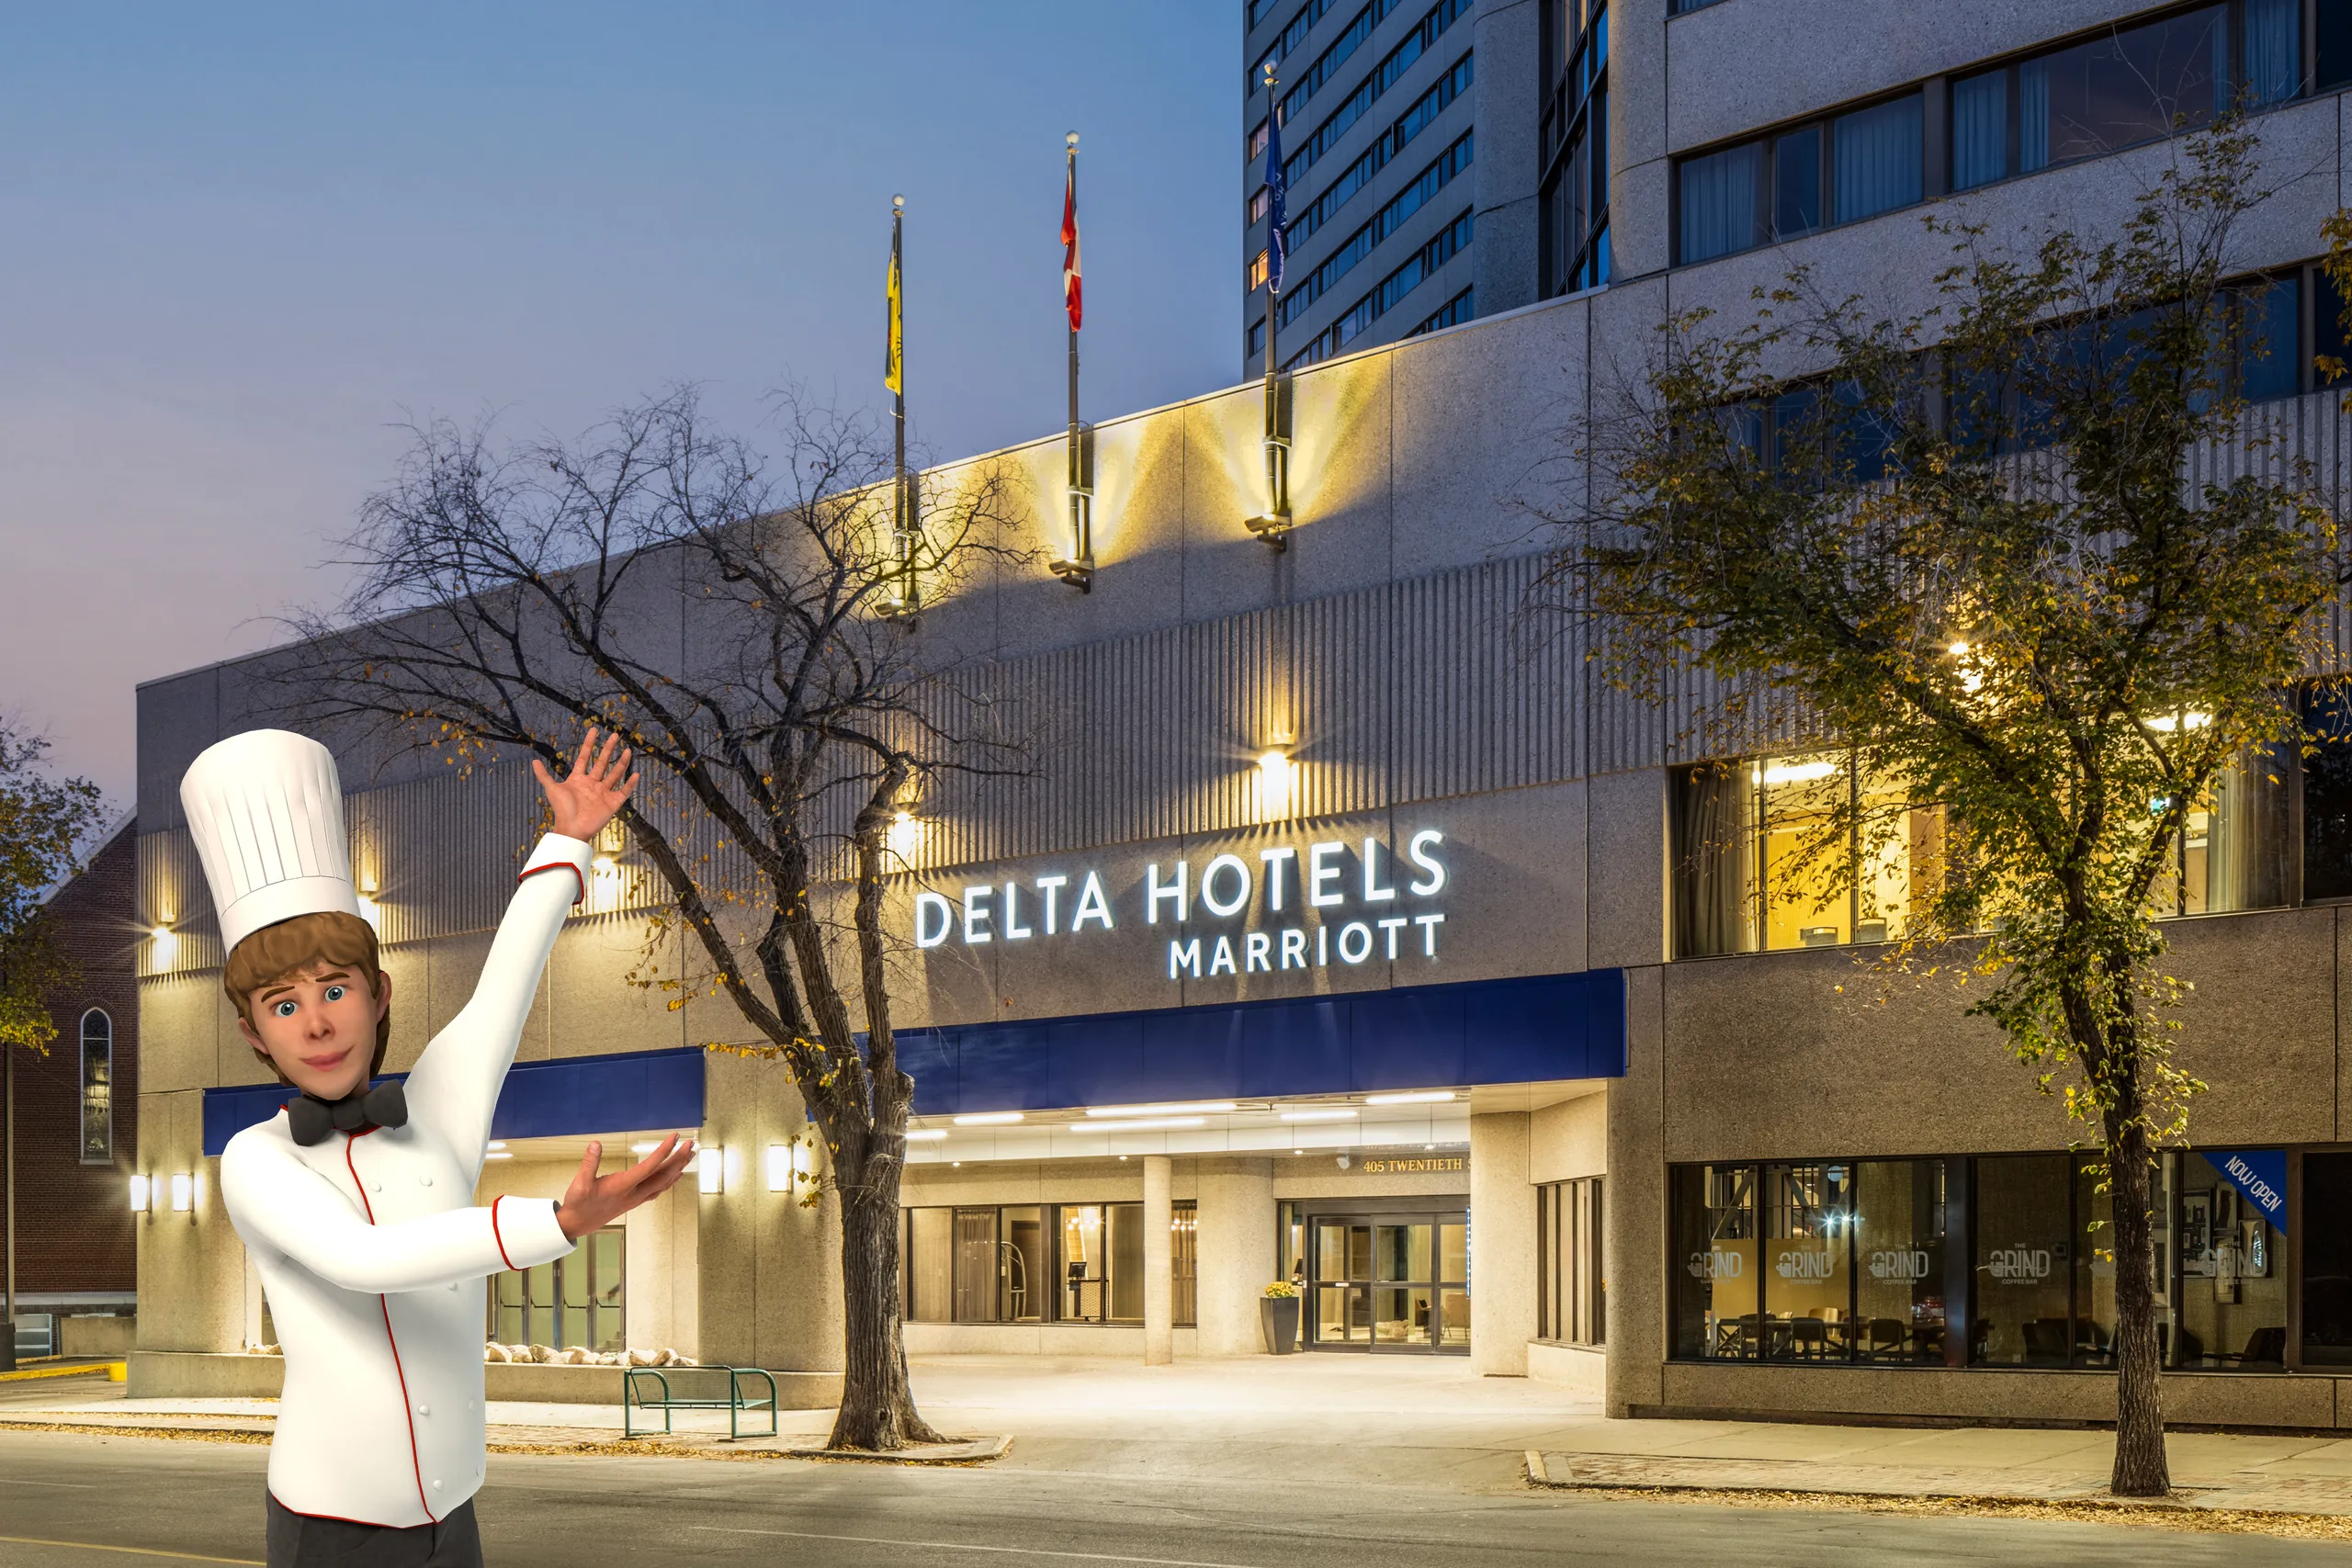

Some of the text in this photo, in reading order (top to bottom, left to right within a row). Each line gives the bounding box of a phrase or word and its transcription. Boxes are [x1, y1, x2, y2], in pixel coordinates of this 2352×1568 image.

[916, 829, 1448, 948] DELTA HOTELS
[1170, 913, 1446, 979] MARRIOTT
[1363, 1161, 1385, 1172] 405
[1387, 1158, 1463, 1172] TWENTIETH
[2224, 1155, 2283, 1213] NOW OPEN
[1687, 1251, 1742, 1278] GRIND
[1775, 1251, 1834, 1278] GRIND
[1869, 1250, 1929, 1278] GRIND
[1987, 1249, 2051, 1278] GRIND
